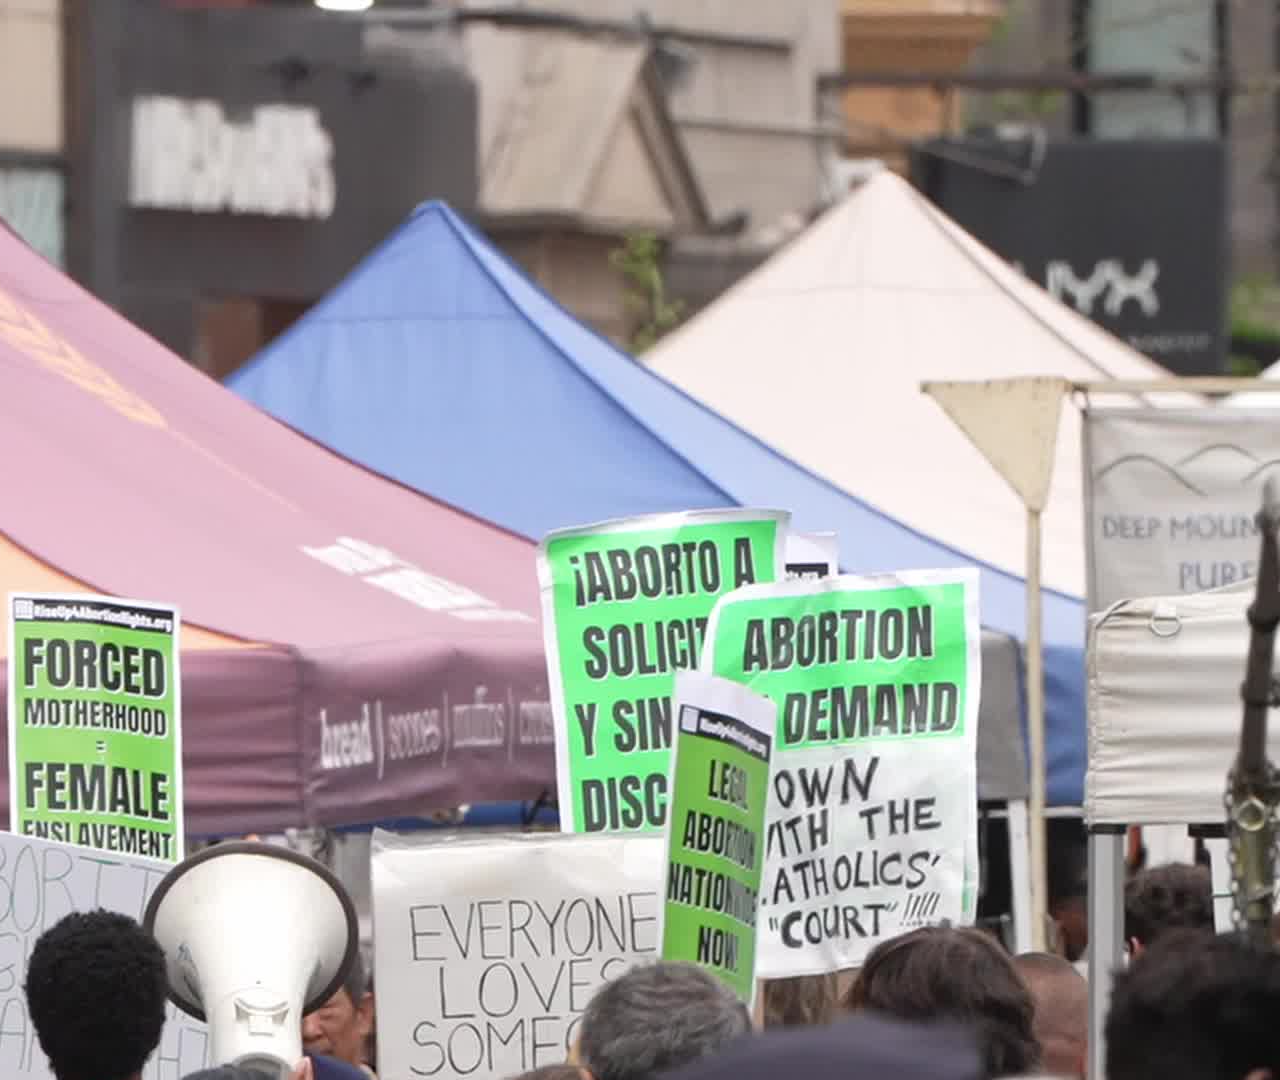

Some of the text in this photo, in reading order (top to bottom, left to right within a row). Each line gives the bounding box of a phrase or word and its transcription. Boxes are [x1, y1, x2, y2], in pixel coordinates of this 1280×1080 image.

[1103, 514, 1160, 540] DEEP
[569, 539, 722, 606] ¡ABORTO
[734, 537, 756, 587] A
[24, 638, 166, 697] FORCED
[742, 604, 935, 672] ABORTION
[24, 697, 167, 737] MOTHERHOOD
[320, 702, 374, 770] bread
[574, 703, 598, 756] Y
[784, 681, 959, 745] DEMAND
[25, 762, 169, 821] FEMALE
[858, 796, 943, 841] THE
[761, 850, 941, 906] ATHOLICS'
[410, 892, 657, 961] EVERYONE
